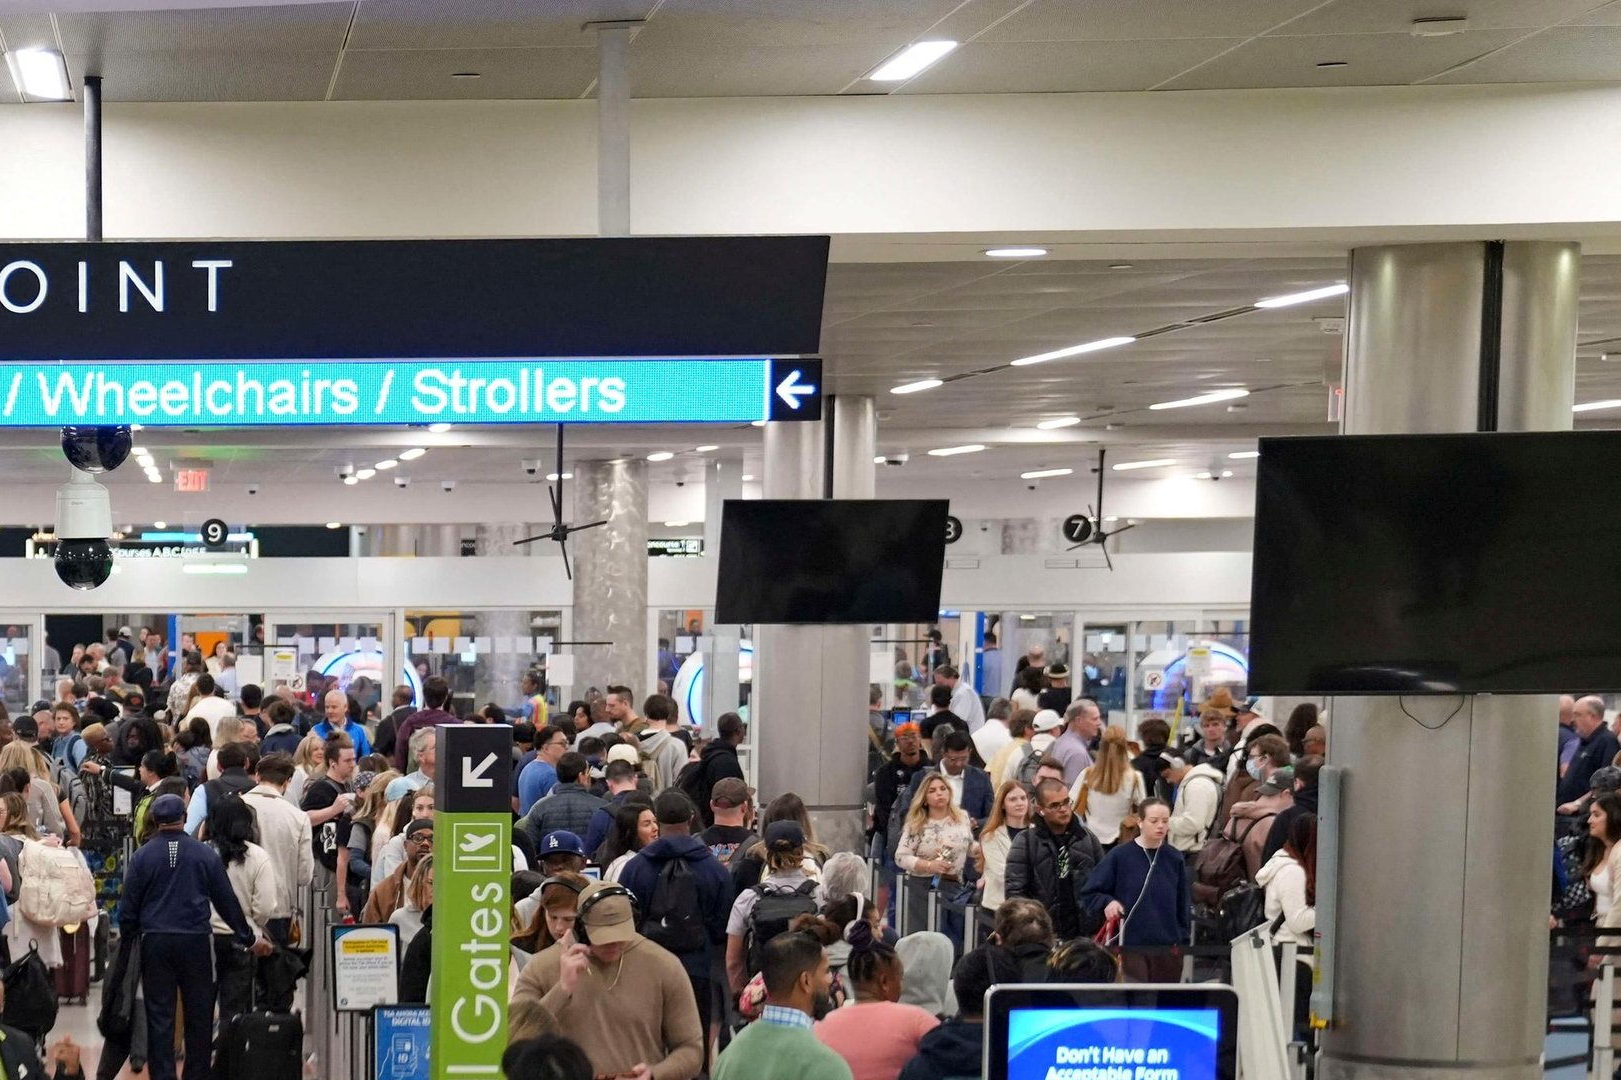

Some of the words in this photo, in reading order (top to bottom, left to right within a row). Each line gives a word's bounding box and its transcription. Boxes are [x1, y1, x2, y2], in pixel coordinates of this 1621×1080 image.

[3, 371, 22, 417] /
[37, 369, 359, 417] Wheelchairs
[376, 368, 395, 414] /
[411, 367, 626, 414] Strollers
[180, 470, 207, 491] EXIT
[207, 523, 222, 542] 9
[1069, 521, 1084, 538] 7
[451, 882, 503, 1044] Gates
[392, 1017, 421, 1027] DIGITAL
[397, 1052, 409, 1064] ID
[1056, 1046, 1099, 1064] Don't
[1102, 1046, 1144, 1064] Have
[1147, 1048, 1168, 1063] an
